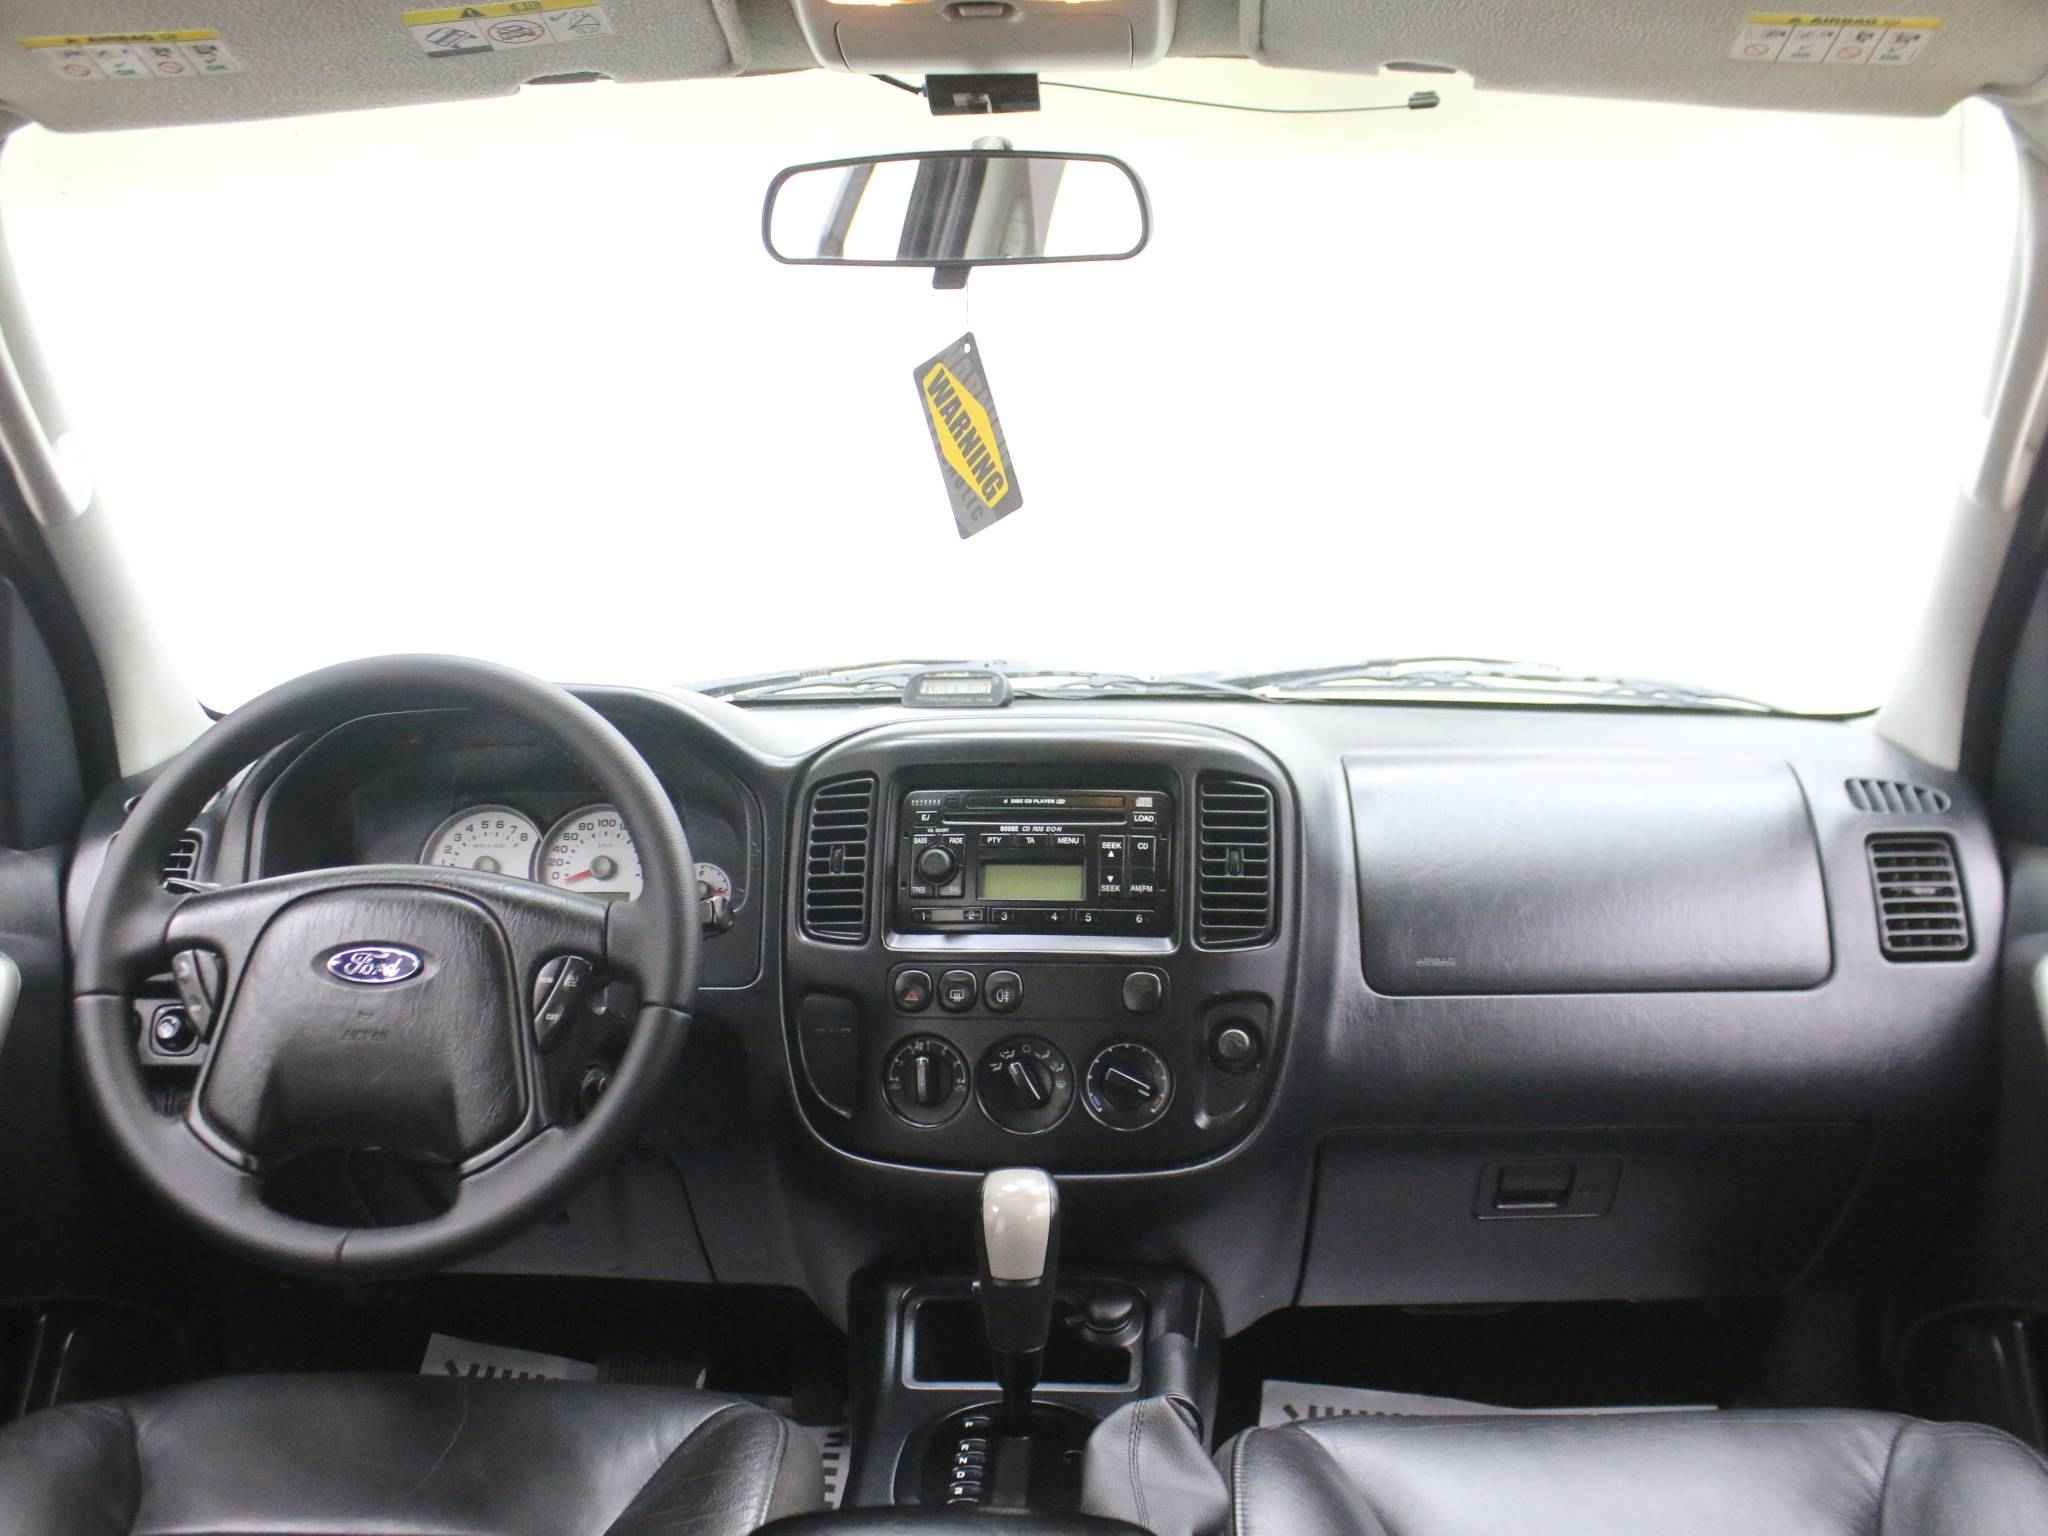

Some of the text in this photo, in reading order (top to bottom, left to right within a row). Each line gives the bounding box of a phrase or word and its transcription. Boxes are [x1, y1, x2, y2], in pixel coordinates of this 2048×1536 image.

[927, 367, 1005, 501] WARNING
[598, 819, 616, 828] 100
[1133, 815, 1155, 823] LOAD
[465, 824, 474, 833] 4
[481, 820, 489, 829] 5
[495, 820, 504, 829] 6
[579, 822, 594, 831] 80
[510, 825, 518, 834] 7
[454, 833, 462, 842] 3
[520, 832, 529, 841] 8
[563, 832, 578, 841] 60
[986, 836, 1002, 844] PTY
[443, 845, 452, 854] 2
[552, 845, 568, 854] 40
[1137, 842, 1149, 850] CD
[546, 858, 564, 867] 20
[552, 871, 560, 880] 0
[920, 911, 926, 920] 1
[968, 911, 975, 920] 2
[1000, 911, 1008, 921] 3
[1050, 911, 1058, 921] 4
[1085, 912, 1092, 922] 5
[1135, 914, 1143, 923] 6
[344, 953, 403, 977] Ford
